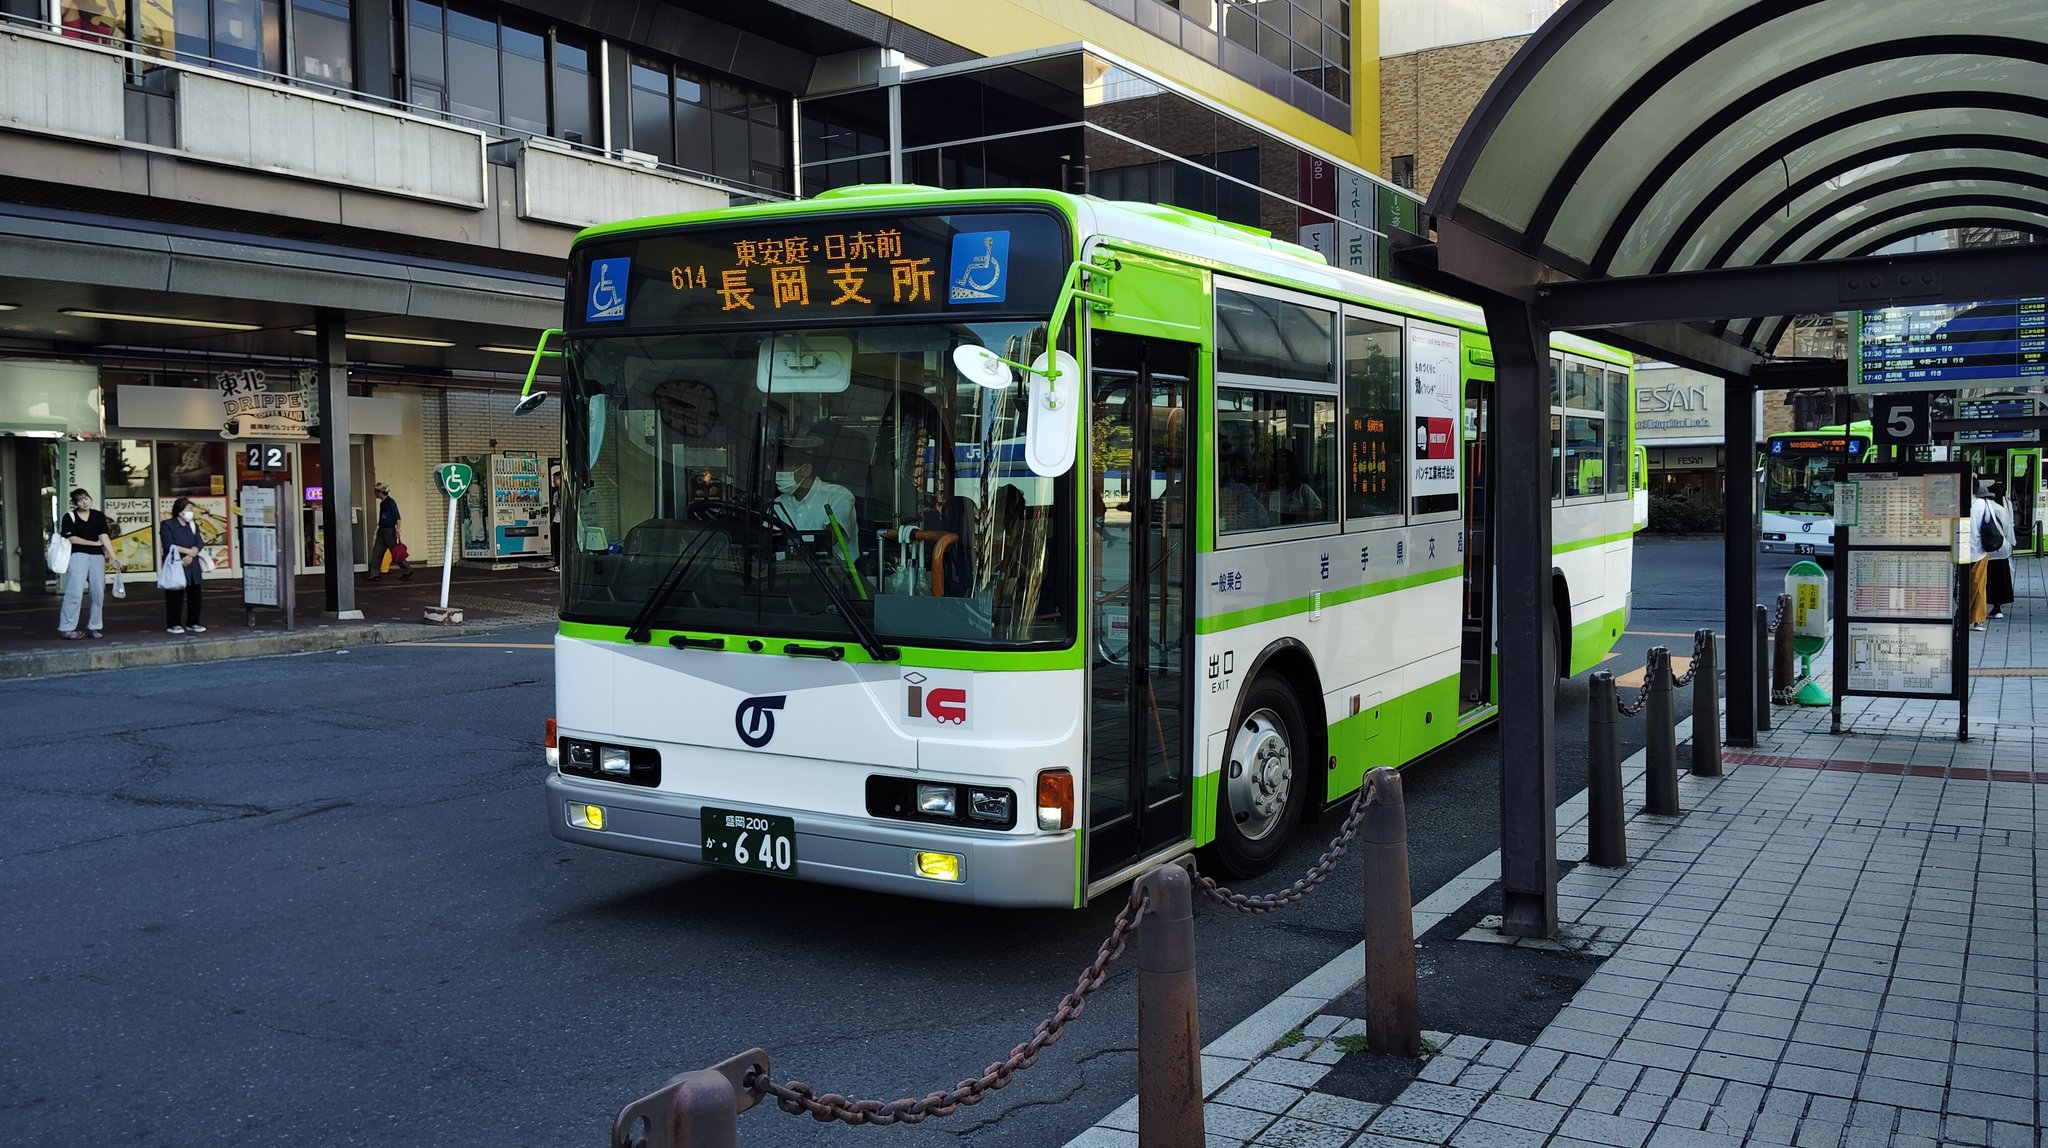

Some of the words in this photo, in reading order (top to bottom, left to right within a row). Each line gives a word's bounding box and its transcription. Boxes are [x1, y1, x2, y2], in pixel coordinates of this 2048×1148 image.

[733, 229, 901, 267] 東安庭・日赤前
[671, 265, 707, 290] 614
[717, 257, 935, 311] 長岡支所
[220, 370, 265, 397] 東北
[1887, 405, 1915, 438] 5
[69, 450, 78, 487] Travel
[267, 448, 282, 466] 2
[106, 500, 150, 510] ドリッパーズ
[1211, 571, 1243, 593] 一般乗合
[1209, 650, 1234, 679] 出口
[1211, 679, 1230, 694] EXIT
